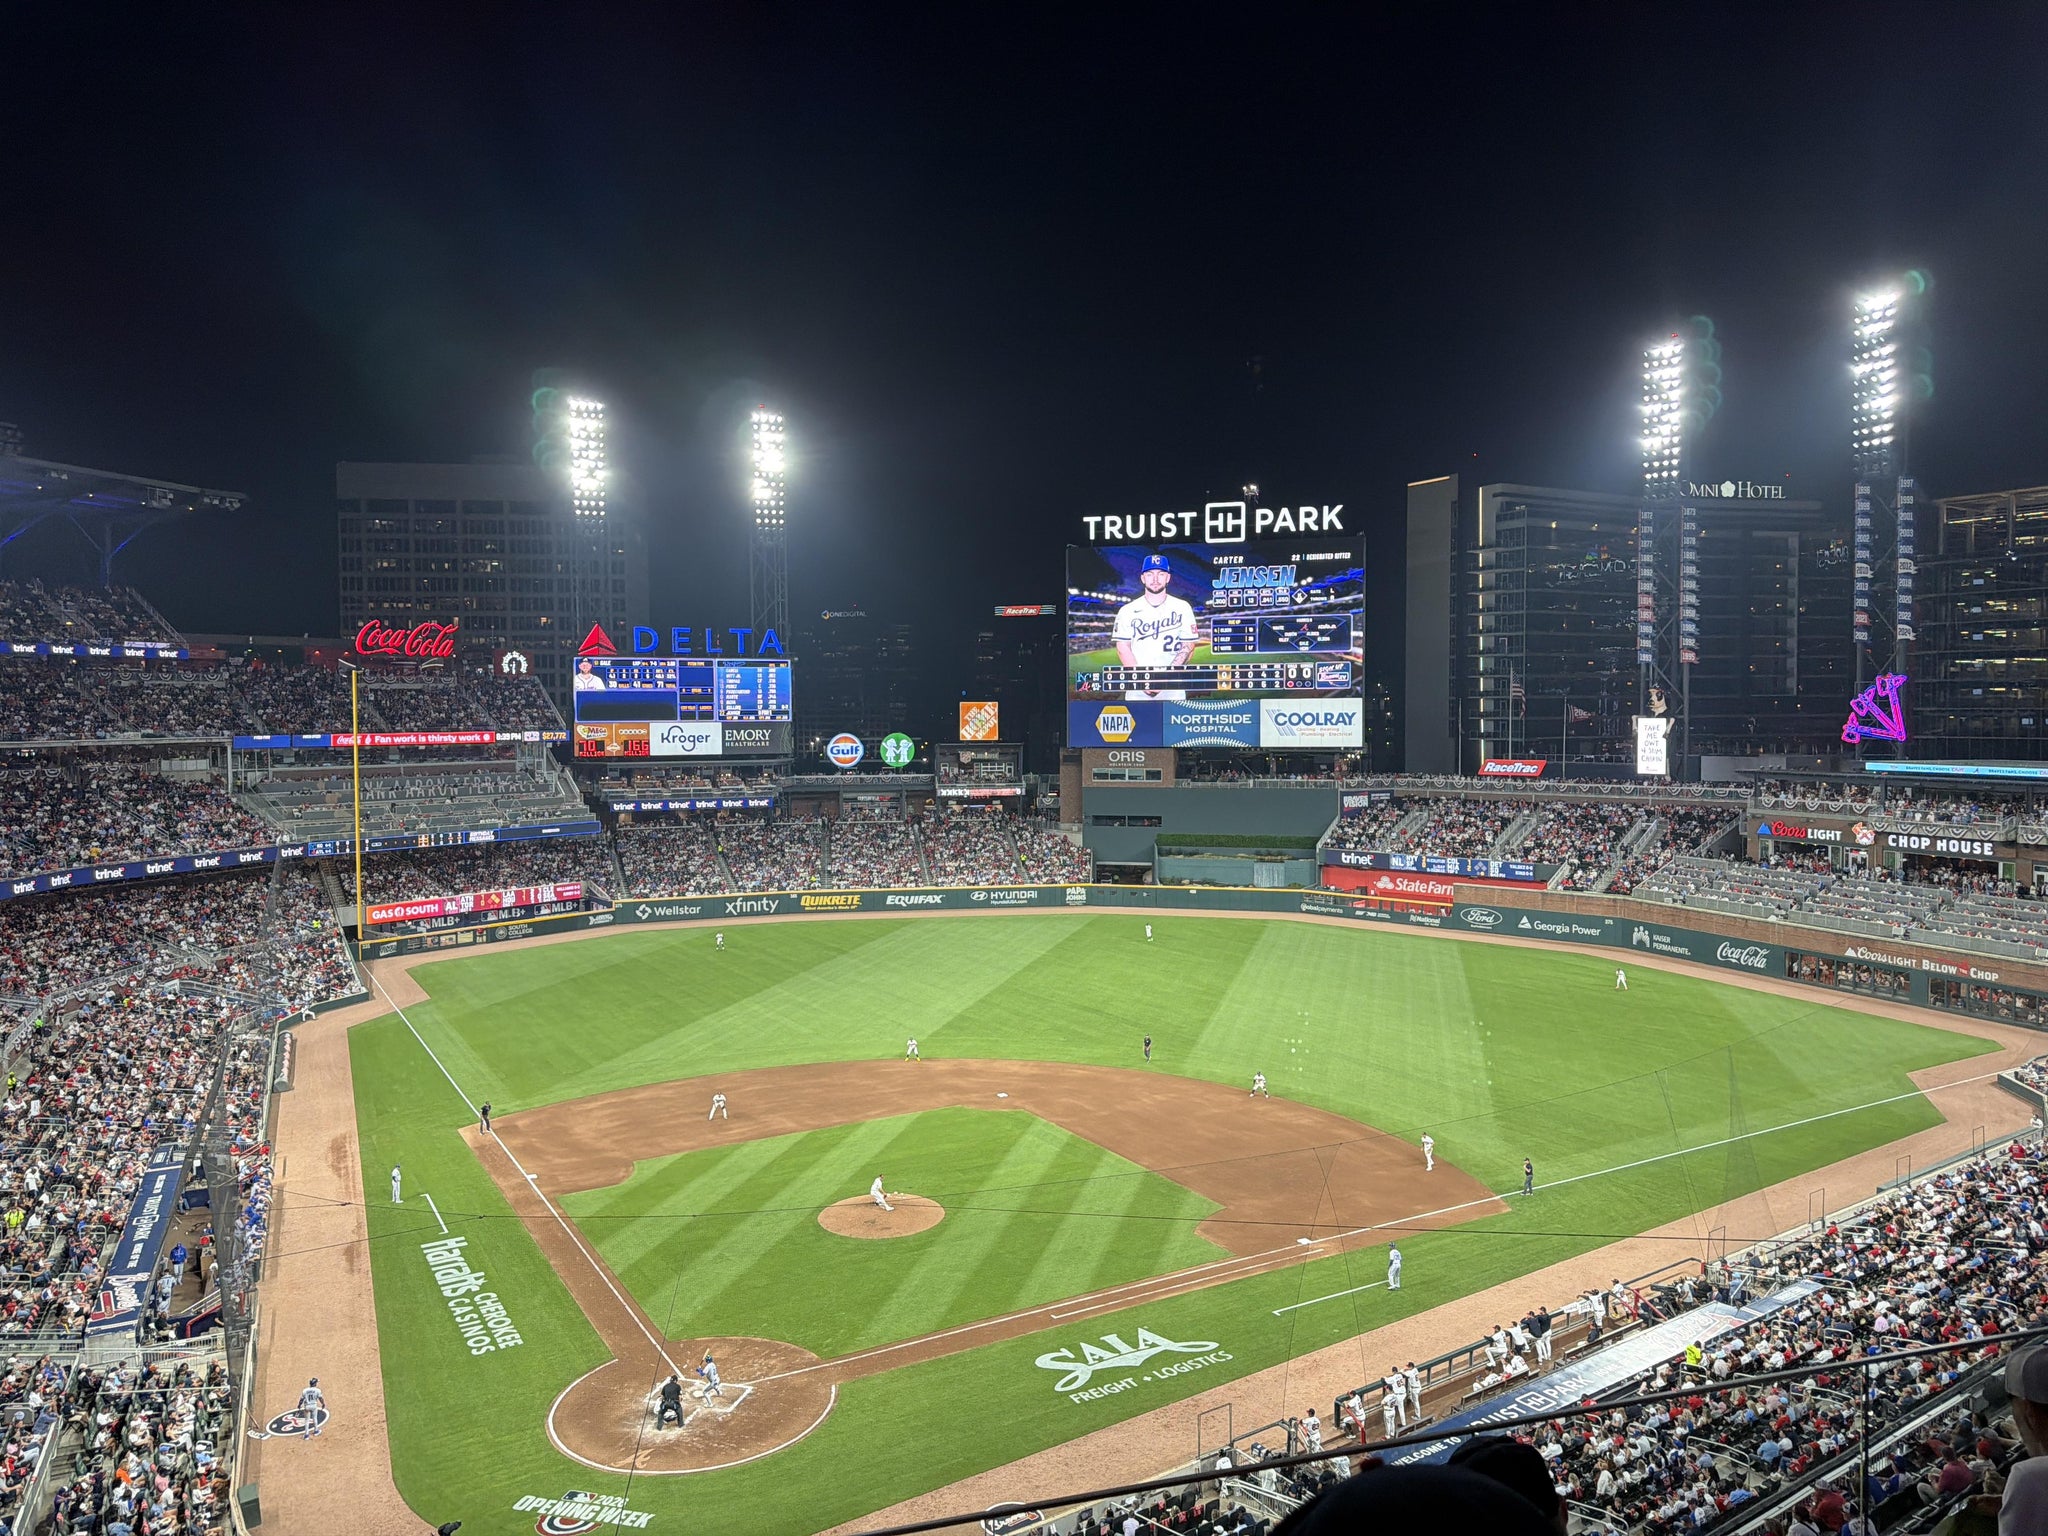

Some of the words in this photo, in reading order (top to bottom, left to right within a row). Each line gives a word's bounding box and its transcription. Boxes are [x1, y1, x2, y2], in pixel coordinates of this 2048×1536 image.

[1737, 480, 1787, 499] HOTEL
[1083, 512, 1197, 540] TRUIST
[1255, 504, 1344, 534] PARK
[1213, 556, 1244, 565] CARTER
[1212, 565, 1296, 589] JENSEN
[1005, 606, 1037, 614] RaceTrac
[1131, 611, 1183, 641] Royals
[355, 619, 459, 657] Coca-Cola
[633, 626, 784, 655] DELTA
[1163, 635, 1182, 652] 22
[13, 644, 36, 653] trinet
[52, 645, 74, 655] trinet
[90, 647, 111, 656] trinet
[125, 648, 146, 657] trinet
[159, 650, 179, 658] trinet
[1288, 668, 1297, 678] 0
[1303, 668, 1311, 678] 0
[1101, 716, 1129, 732] NAPA
[1171, 714, 1252, 725] NORTHSIDE
[1274, 711, 1358, 726] COOLRAY
[374, 735, 391, 743] Fan
[393, 734, 417, 743] work
[418, 734, 426, 742] is
[428, 733, 457, 744] thirsty
[458, 733, 481, 741] work
[660, 725, 711, 752] Kroger
[725, 730, 771, 741] EMORY
[579, 740, 596, 751] 70
[628, 740, 649, 751] 166
[829, 745, 860, 756] Gulf
[1109, 751, 1145, 762] ORIS
[1483, 763, 1538, 774] RaceTrac
[613, 803, 637, 811] trinet
[641, 802, 664, 810] trinet
[668, 801, 690, 809] trinet
[695, 800, 718, 808] trinet
[722, 799, 745, 807] trinet
[748, 799, 770, 807] trinet
[1771, 820, 1807, 839] Coors
[1807, 829, 1842, 841] LIGHT
[281, 846, 304, 857] trinet
[1888, 835, 1931, 850] CHOP
[1936, 839, 1993, 856] HOUSE
[194, 856, 221, 868] trinet
[239, 850, 264, 862] trinet
[1341, 852, 1375, 865] trinet
[95, 866, 126, 880] trinet
[147, 861, 175, 874] trinet
[51, 873, 72, 887] trinet
[1394, 877, 1427, 893] State
[13, 880, 36, 895] trinet
[1066, 886, 1087, 895] PAPA
[800, 894, 862, 907] QUIKRETE
[886, 894, 943, 907] EQUIFAX
[990, 890, 1038, 899] HYUNDAI
[1066, 893, 1087, 901] JOHNS
[372, 909, 394, 920] GAS
[405, 903, 439, 915] SOUTH
[445, 901, 459, 911] AL
[551, 901, 578, 913] MLB+
[653, 905, 701, 917] Wellstar
[725, 897, 779, 916] xfinity
[431, 916, 460, 928] MLB+
[1416, 915, 1441, 924] National
[1467, 909, 1495, 924] Ford
[507, 923, 528, 931] SOUTH
[508, 927, 534, 936] COLLEGE
[1533, 920, 1570, 934] Georgia
[1572, 924, 1602, 936] Power
[1652, 934, 1671, 944] KAISER
[1716, 941, 1770, 969] Coca-Cola
[1857, 946, 1888, 963] Coors
[1888, 955, 1917, 969] LIGHT
[420, 1236, 488, 1297] Harrah's
[448, 1298, 496, 1356] CASINOS
[474, 1292, 524, 1350] CHEROKEE
[1034, 1326, 1220, 1392] SAIA
[1069, 1377, 1139, 1404] FREIGHT
[1152, 1350, 1234, 1380] LOGISTICS
[1545, 1373, 1594, 1401] PARK
[1390, 1441, 1448, 1466] WELCOME
[1444, 1436, 1462, 1446] TO
[512, 1494, 601, 1522] OPENING
[595, 1505, 656, 1529] WEEK
